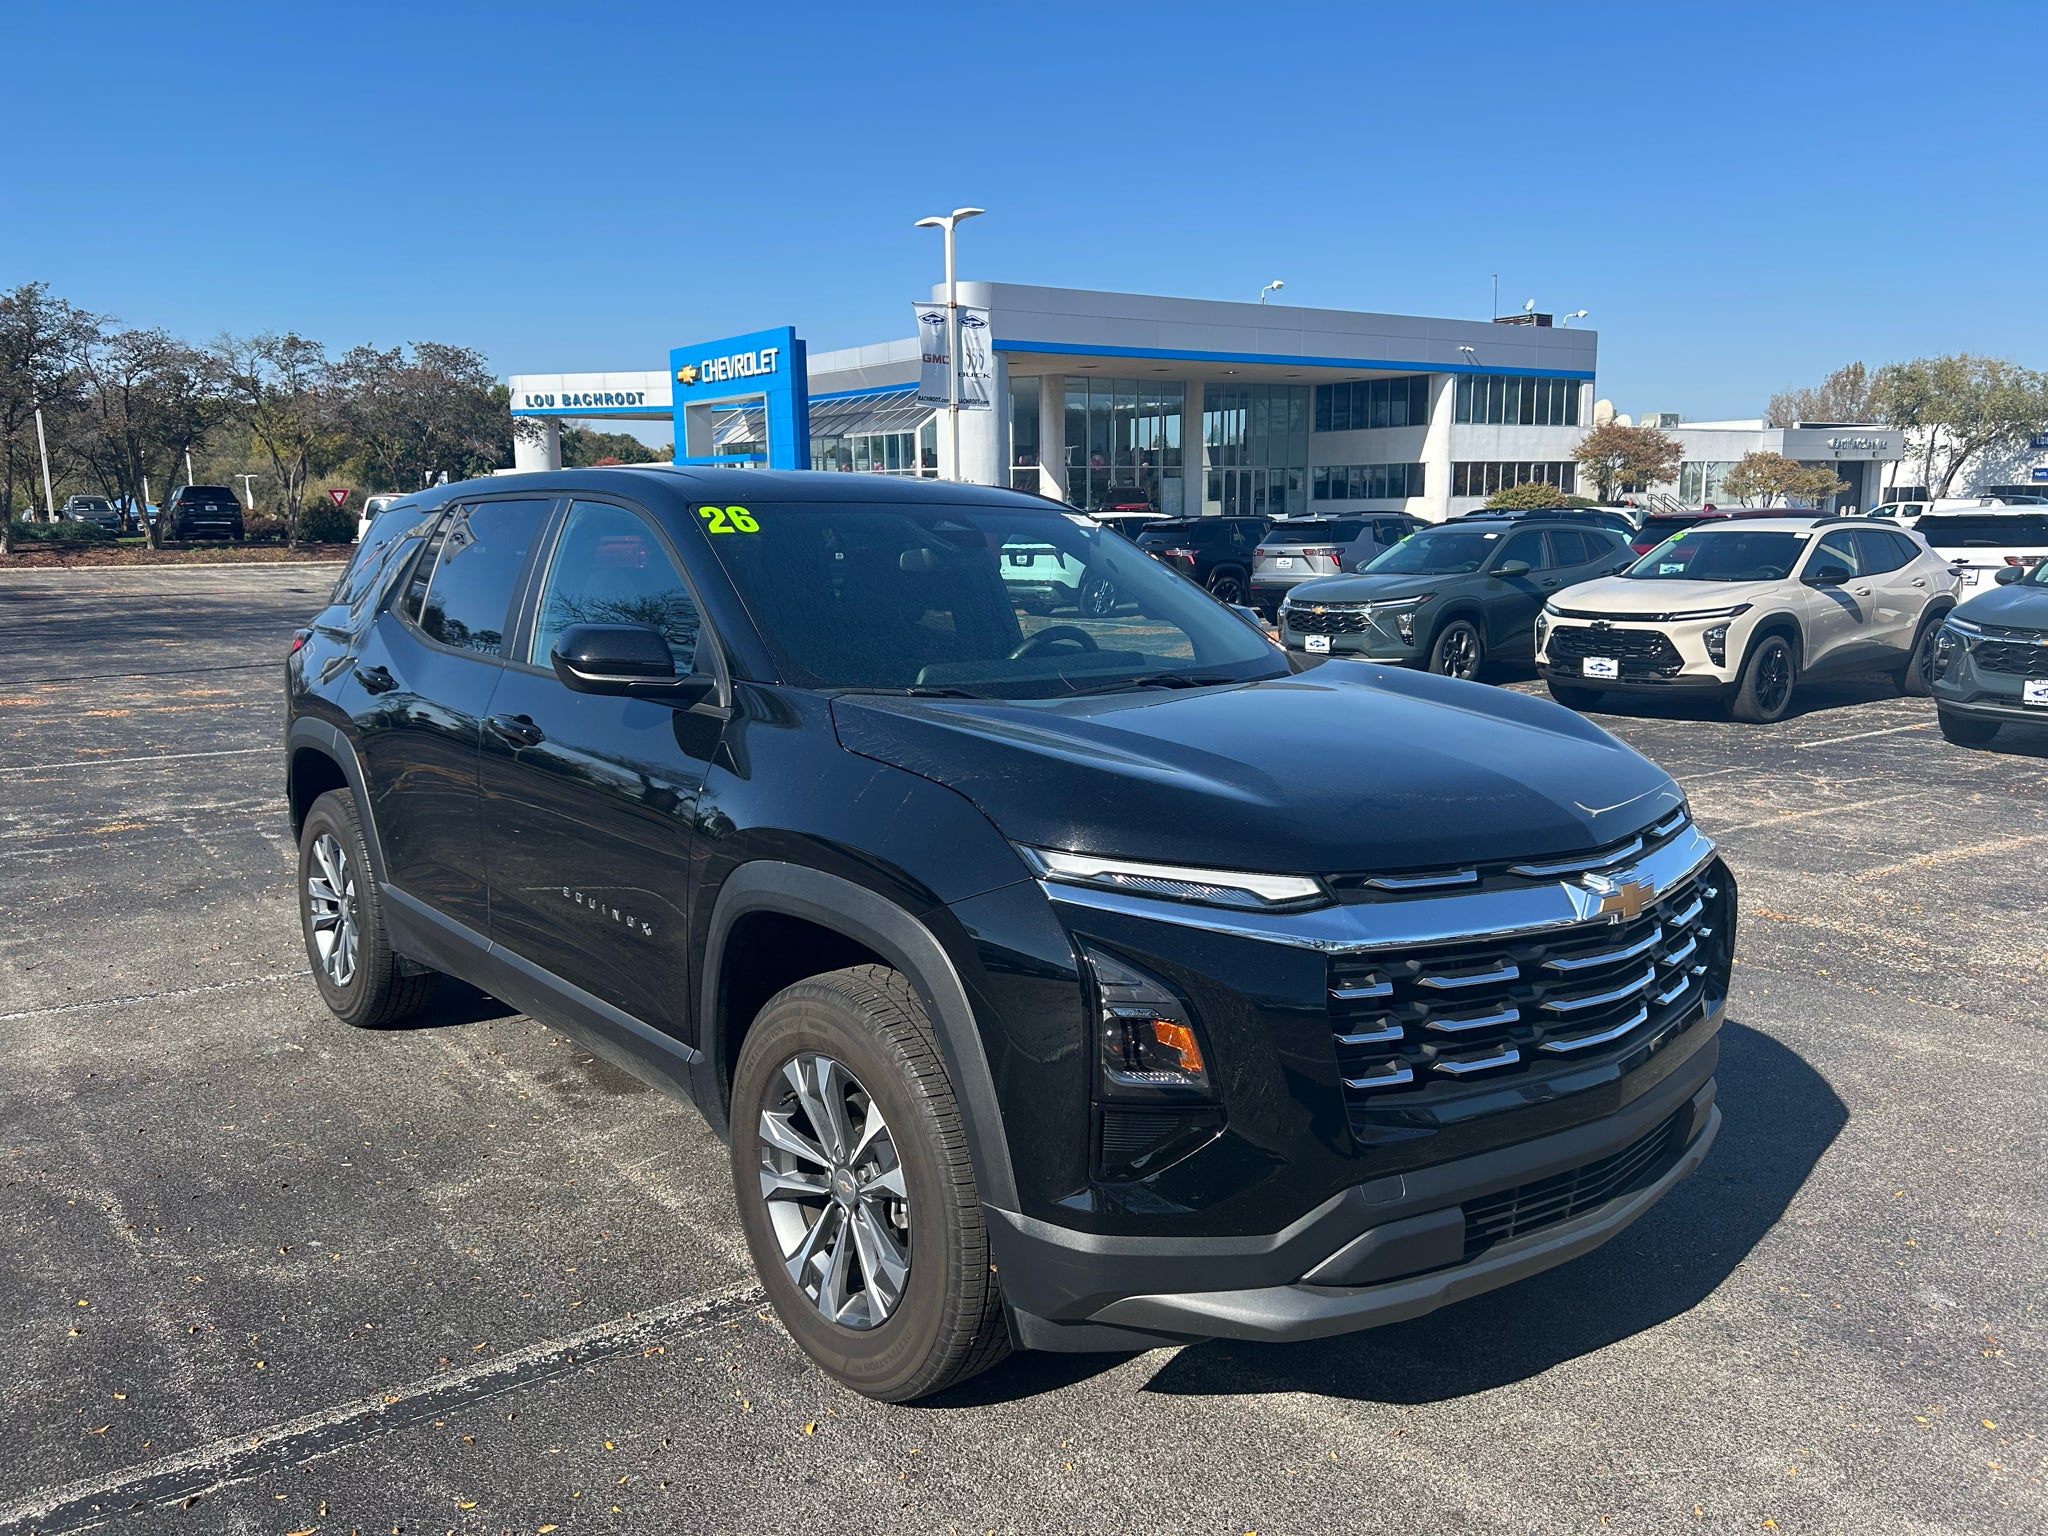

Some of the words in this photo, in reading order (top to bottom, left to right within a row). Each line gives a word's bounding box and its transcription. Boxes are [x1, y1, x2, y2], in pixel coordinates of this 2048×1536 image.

[701, 347, 779, 383] CHEVROLET
[922, 353, 950, 364] GMC
[525, 394, 555, 408] LOU
[561, 391, 645, 407] BACHRODT
[698, 506, 760, 534] 26
[562, 886, 653, 937] EQUINOX
